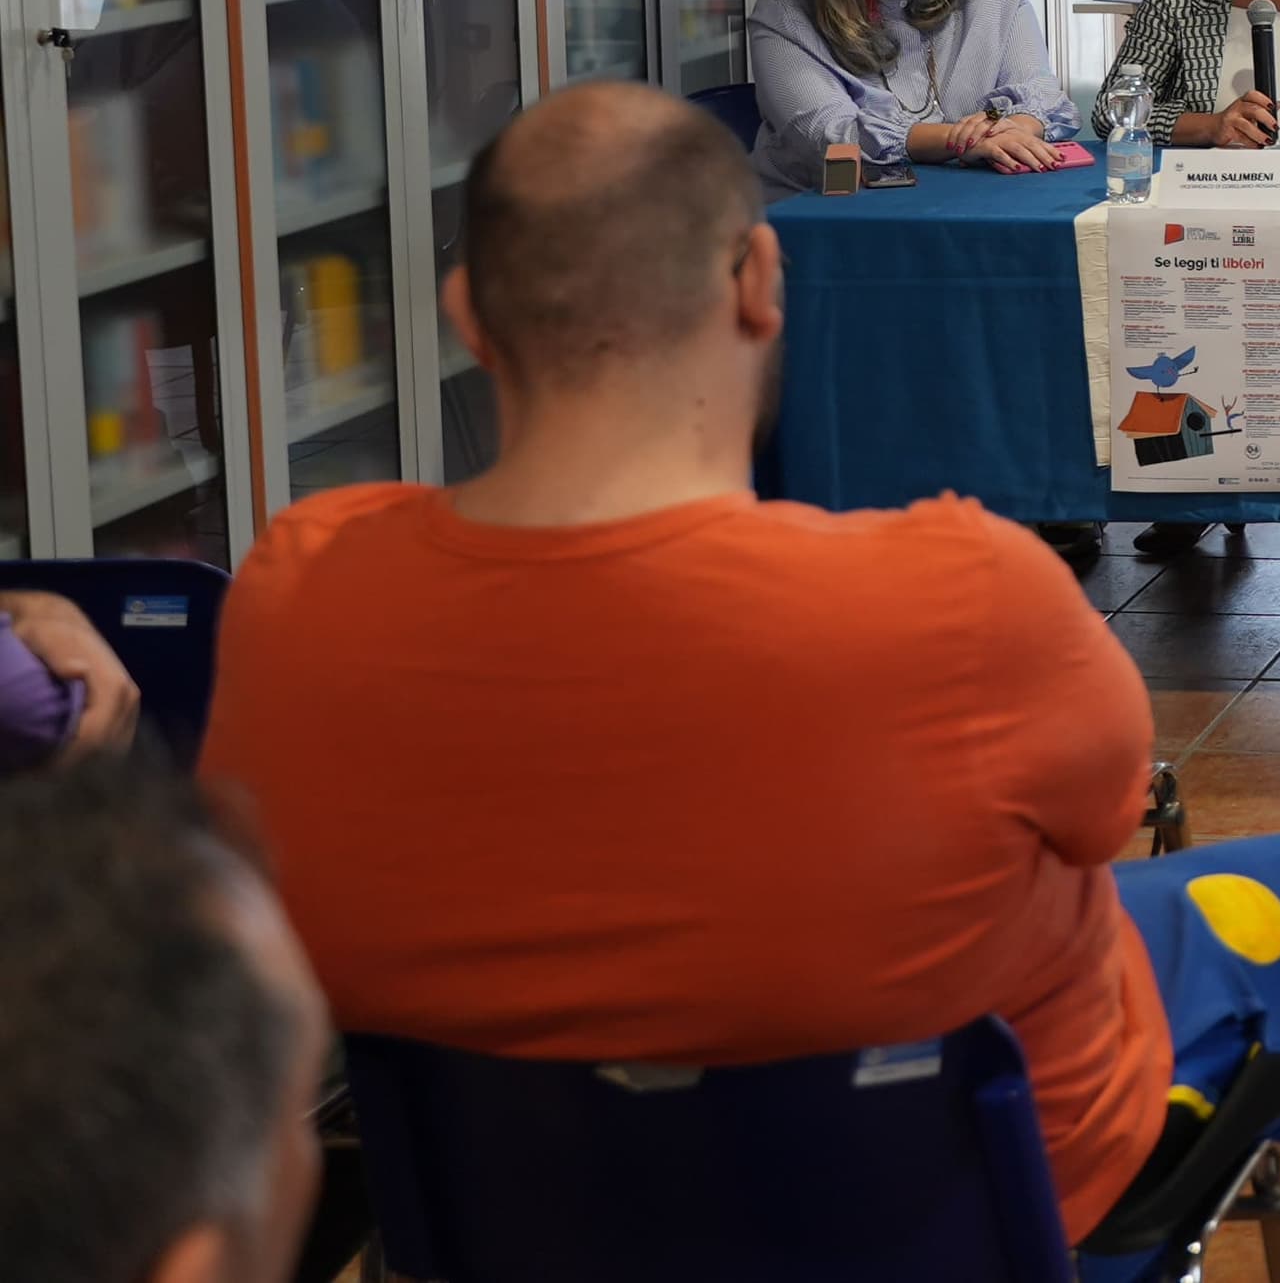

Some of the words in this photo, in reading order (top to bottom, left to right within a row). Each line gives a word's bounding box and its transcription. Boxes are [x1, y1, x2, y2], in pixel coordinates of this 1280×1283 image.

[1187, 173, 1218, 182] MARIA
[1220, 172, 1274, 182] SALIMBENI
[1154, 256, 1171, 268] Se
[1174, 256, 1208, 271] leggi
[1210, 257, 1220, 269] ti
[1222, 258, 1265, 270] lib(e)ri
